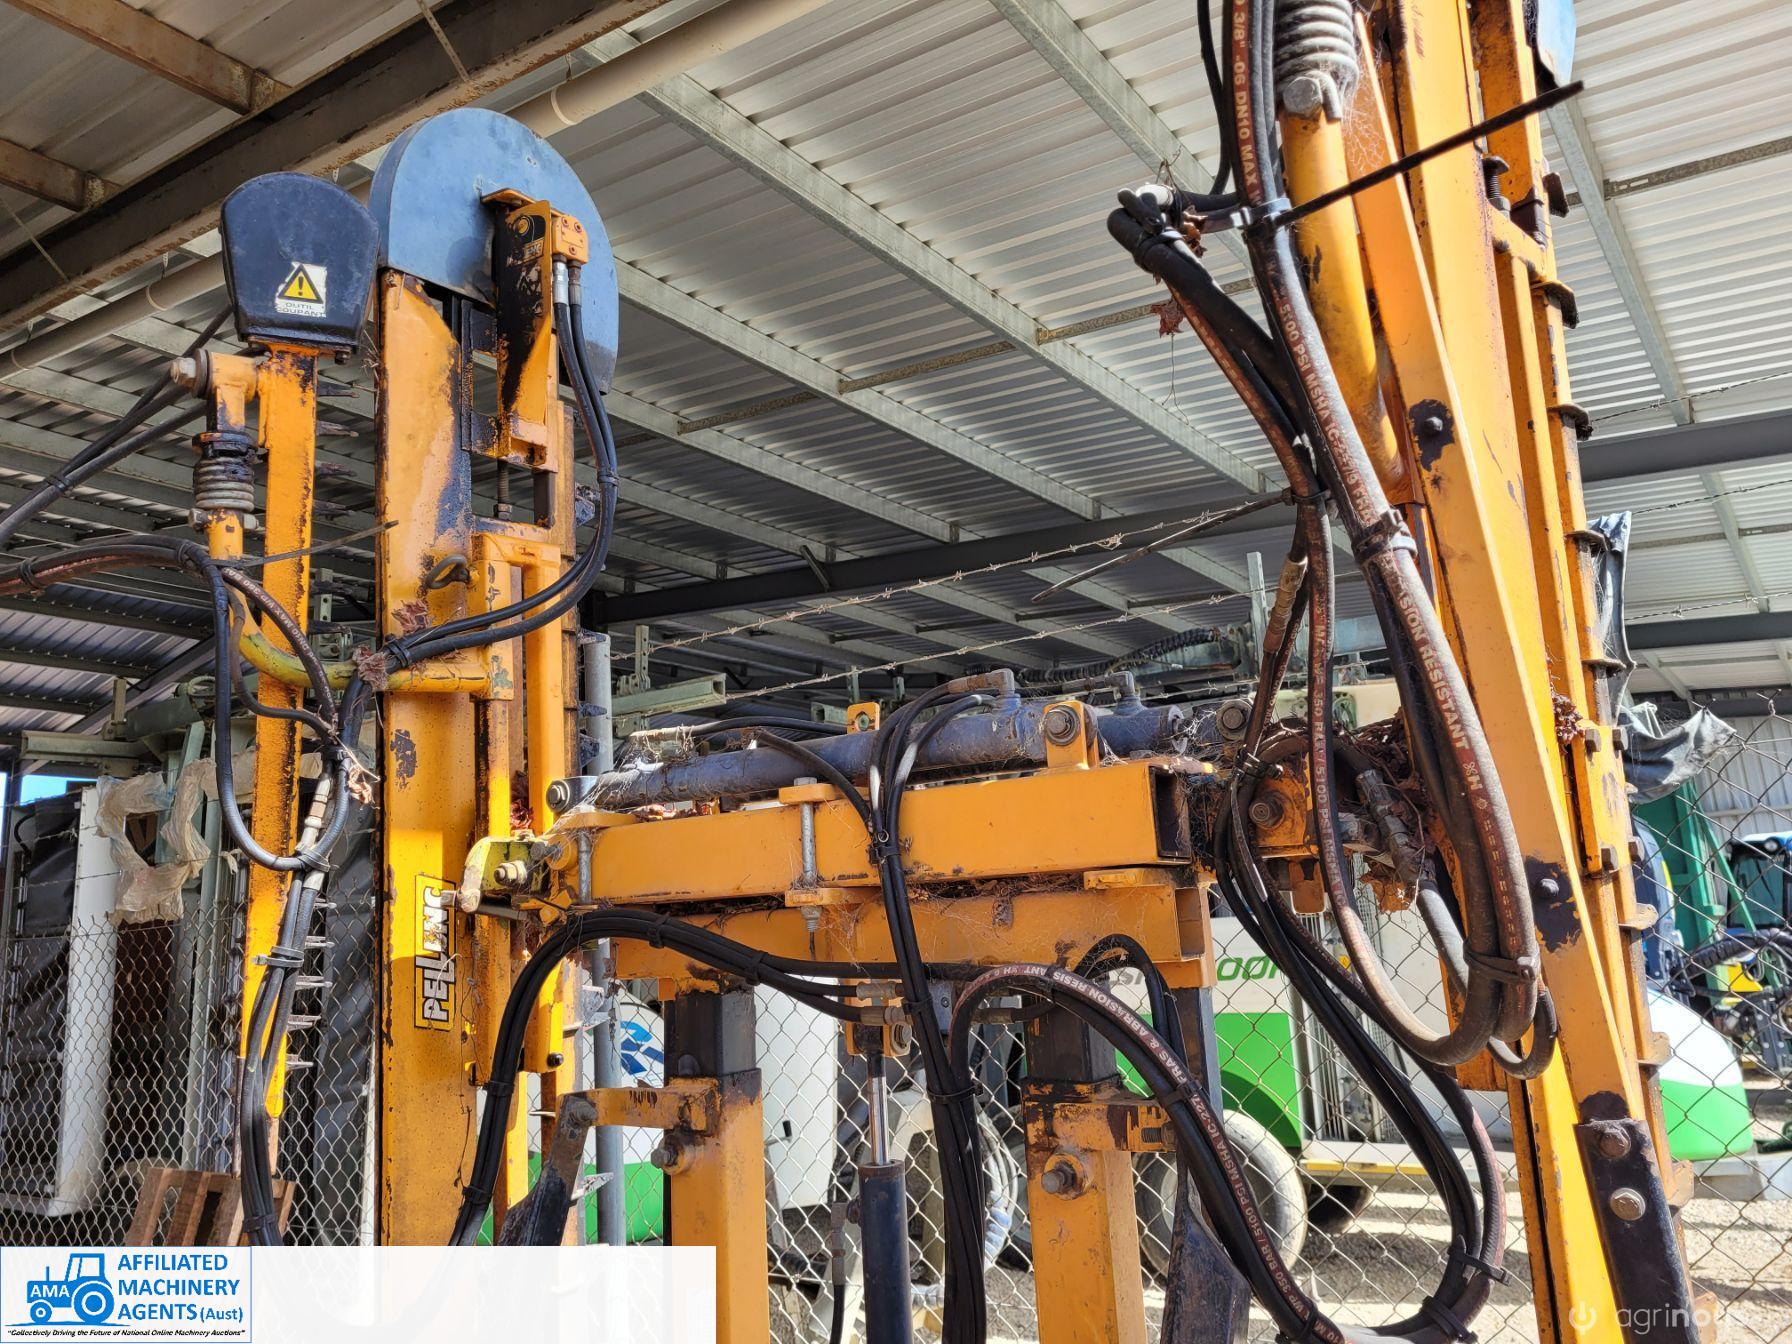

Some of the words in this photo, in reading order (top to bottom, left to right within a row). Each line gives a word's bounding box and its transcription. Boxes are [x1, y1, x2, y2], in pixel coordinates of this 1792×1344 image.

[1235, 91, 1250, 140] DN10
[1241, 144, 1258, 186] MAX
[277, 307, 325, 317] OUPANT
[1294, 343, 1311, 372] PSI
[260, 593, 275, 609] WP
[274, 606, 294, 629] MAX
[1419, 643, 1469, 750] RESISTANT
[1088, 988, 1149, 1037] ABRASION
[1149, 1036, 1160, 1049] &
[1158, 1050, 1188, 1085] FRAS
[1190, 1094, 1223, 1145] IC-227/
[1218, 1142, 1241, 1183] MSHA
[1232, 1183, 1248, 1208] PSI
[1244, 1208, 1263, 1238] 5100
[1262, 1245, 1278, 1270] BAR
[1275, 1272, 1291, 1293] 350
